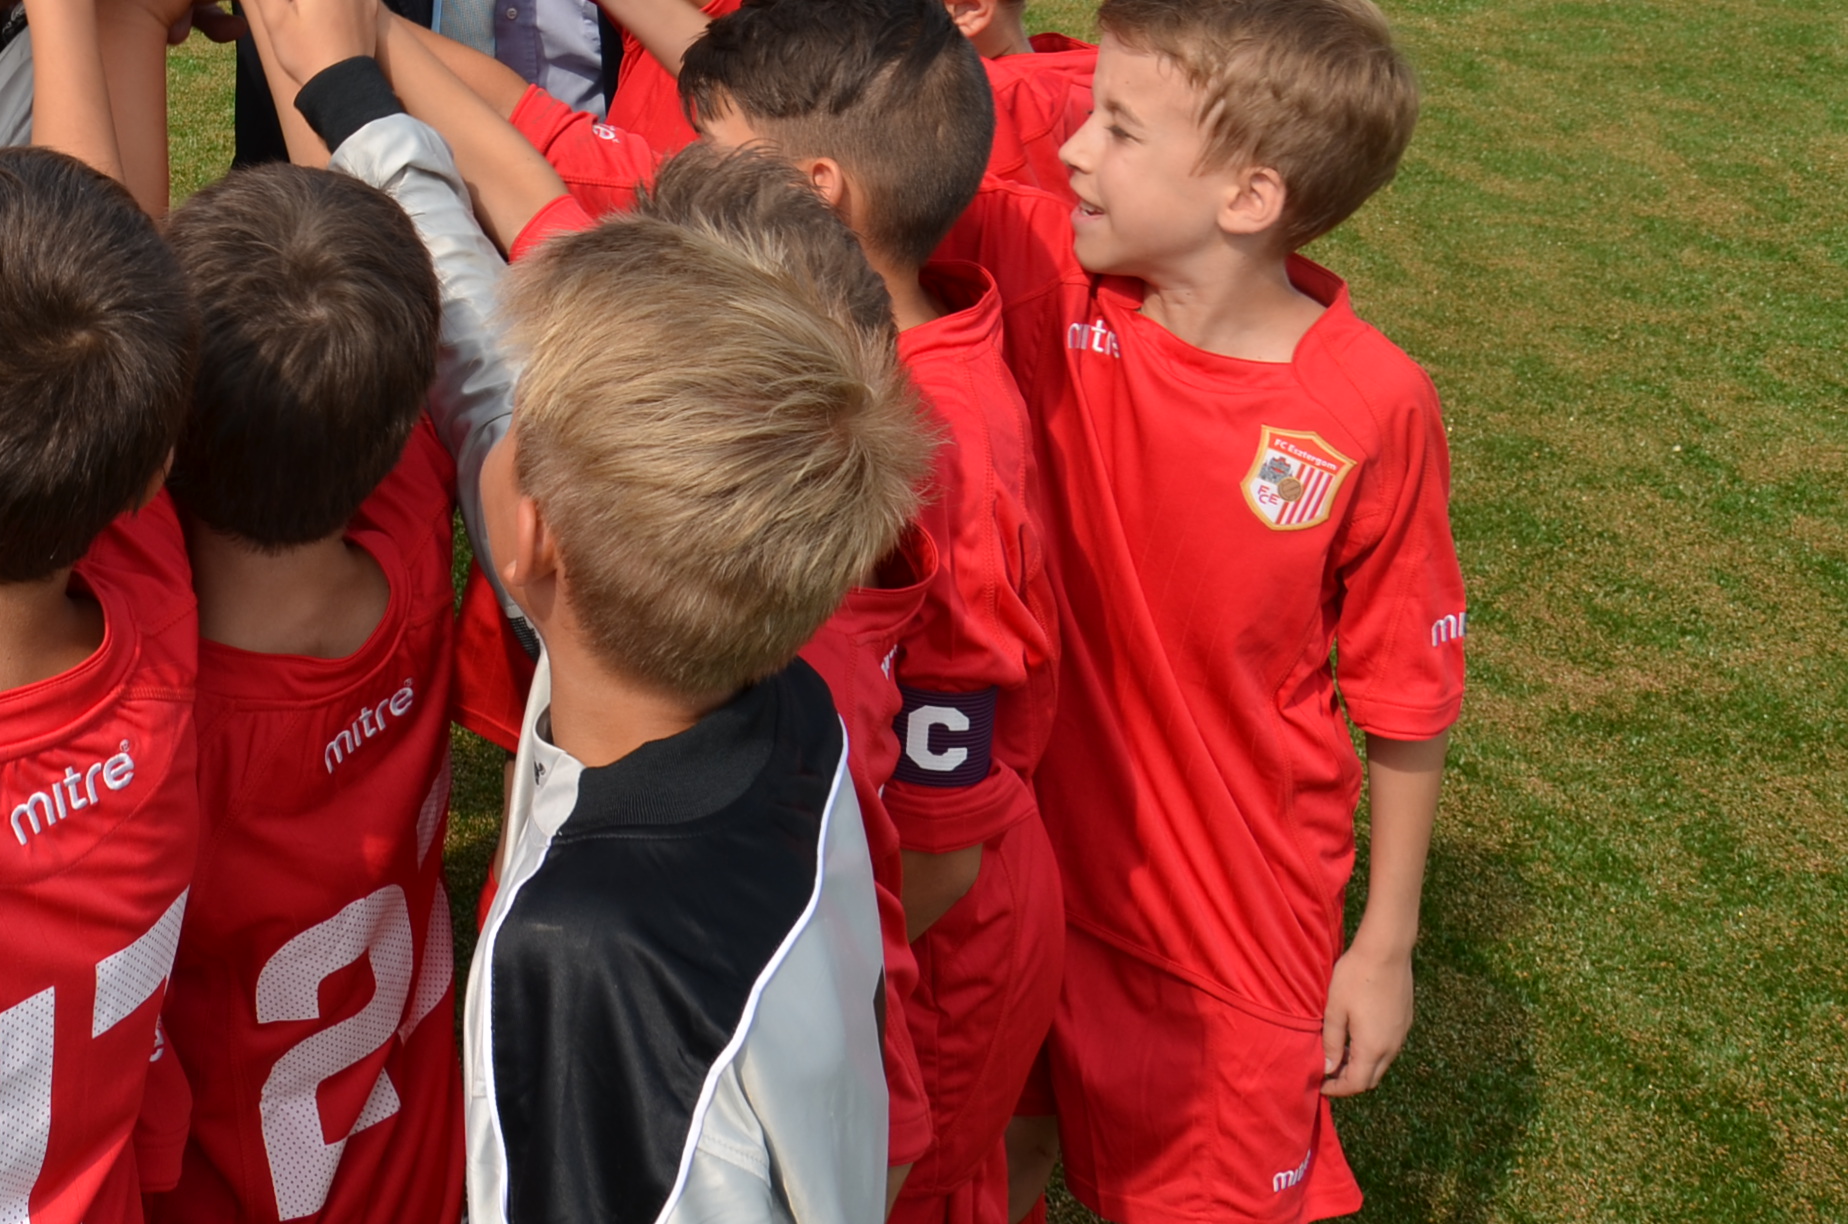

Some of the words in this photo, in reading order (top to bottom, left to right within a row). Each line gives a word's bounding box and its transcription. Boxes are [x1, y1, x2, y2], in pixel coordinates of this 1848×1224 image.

[1274, 438, 1288, 449] FC
[1287, 444, 1337, 470] Esztergom
[324, 685, 414, 774] mitre
[906, 704, 970, 771] C
[10, 749, 135, 846] mitre
